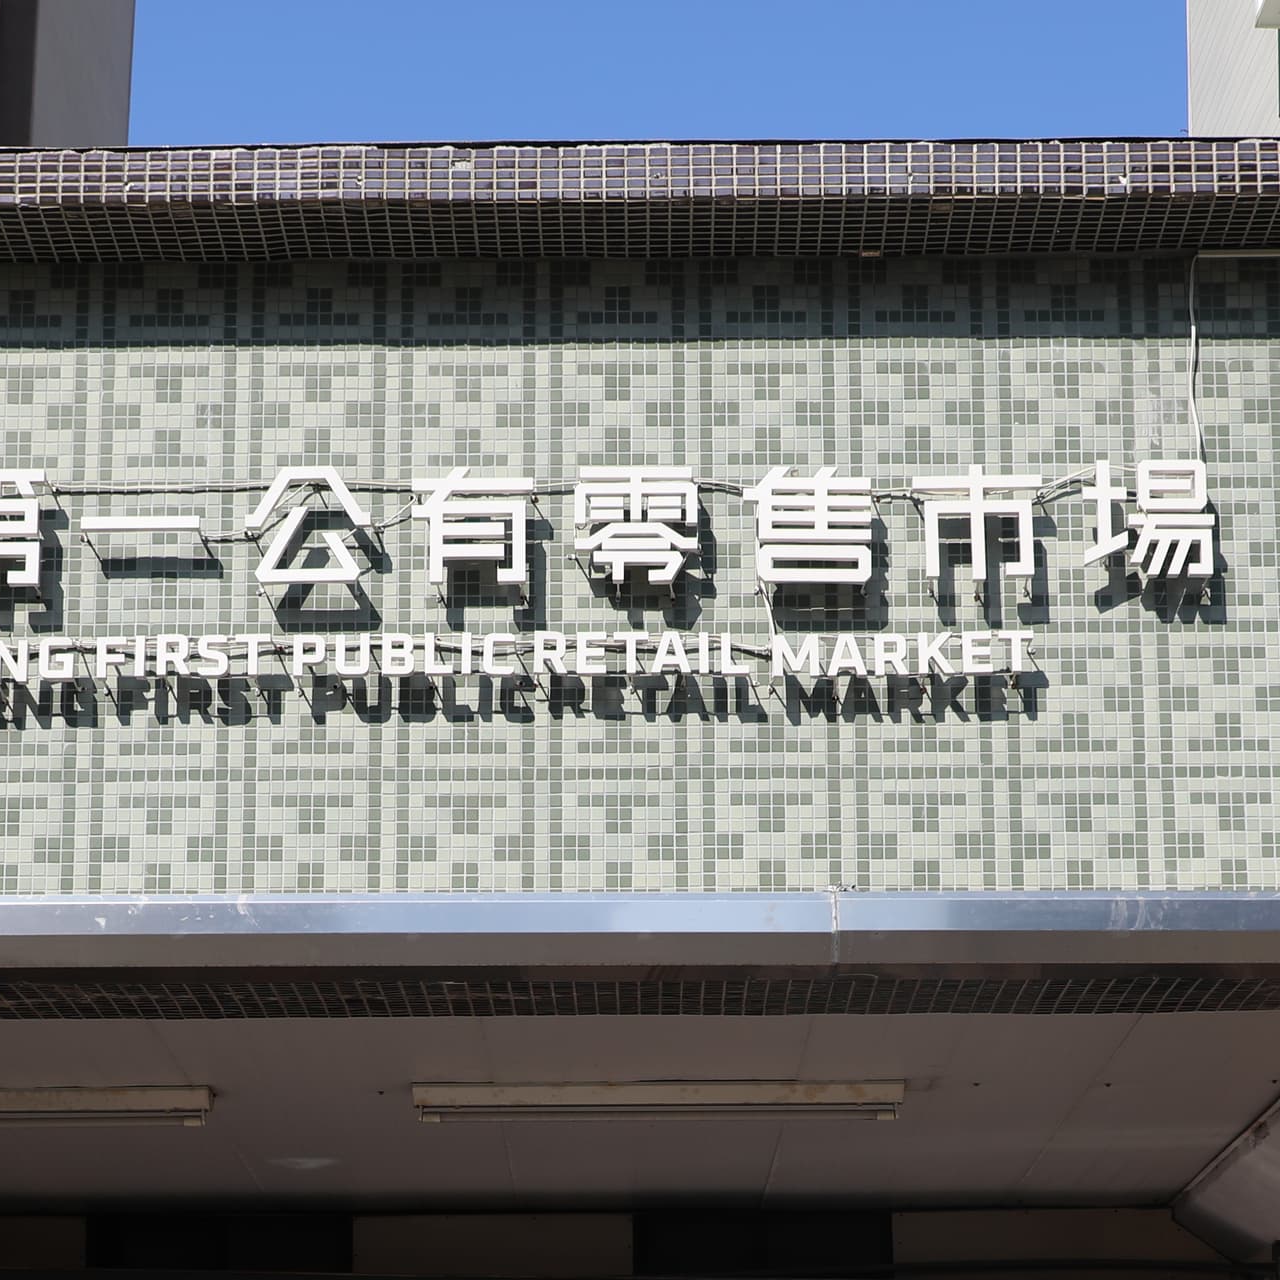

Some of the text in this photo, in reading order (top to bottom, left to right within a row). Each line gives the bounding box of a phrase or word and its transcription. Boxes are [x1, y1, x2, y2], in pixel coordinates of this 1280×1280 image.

[96, 633, 263, 680] FIRST
[292, 631, 516, 679] PUBLIC
[533, 631, 750, 677] RETAIL
[772, 629, 1033, 677] MARKET
